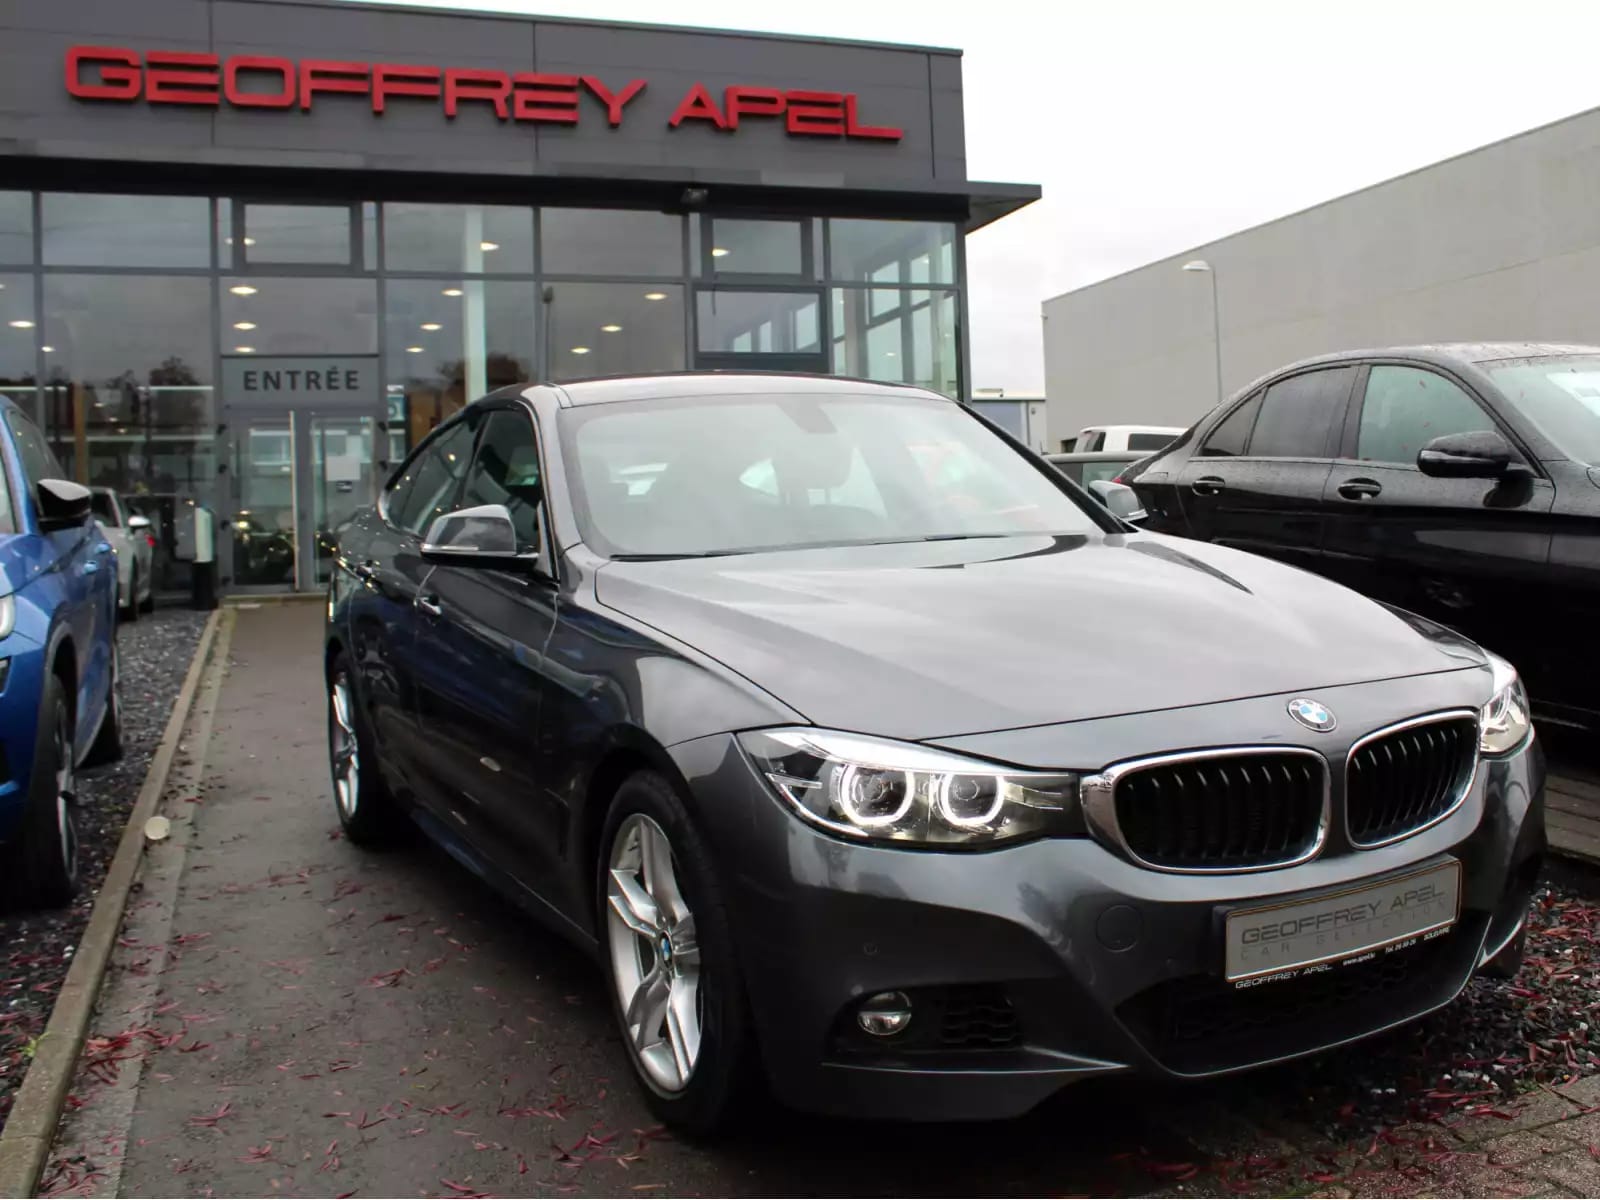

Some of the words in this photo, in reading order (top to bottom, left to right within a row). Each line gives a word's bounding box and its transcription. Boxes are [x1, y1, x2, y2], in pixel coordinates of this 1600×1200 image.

[65, 45, 647, 128] GEOFFREY
[668, 79, 904, 141] APEL
[243, 365, 361, 391] ENTRÉE
[1241, 900, 1382, 944] GEOFFREY
[1390, 883, 1446, 910] APEL
[1235, 970, 1300, 989] GEOFFREY
[1303, 963, 1333, 976] APEL
